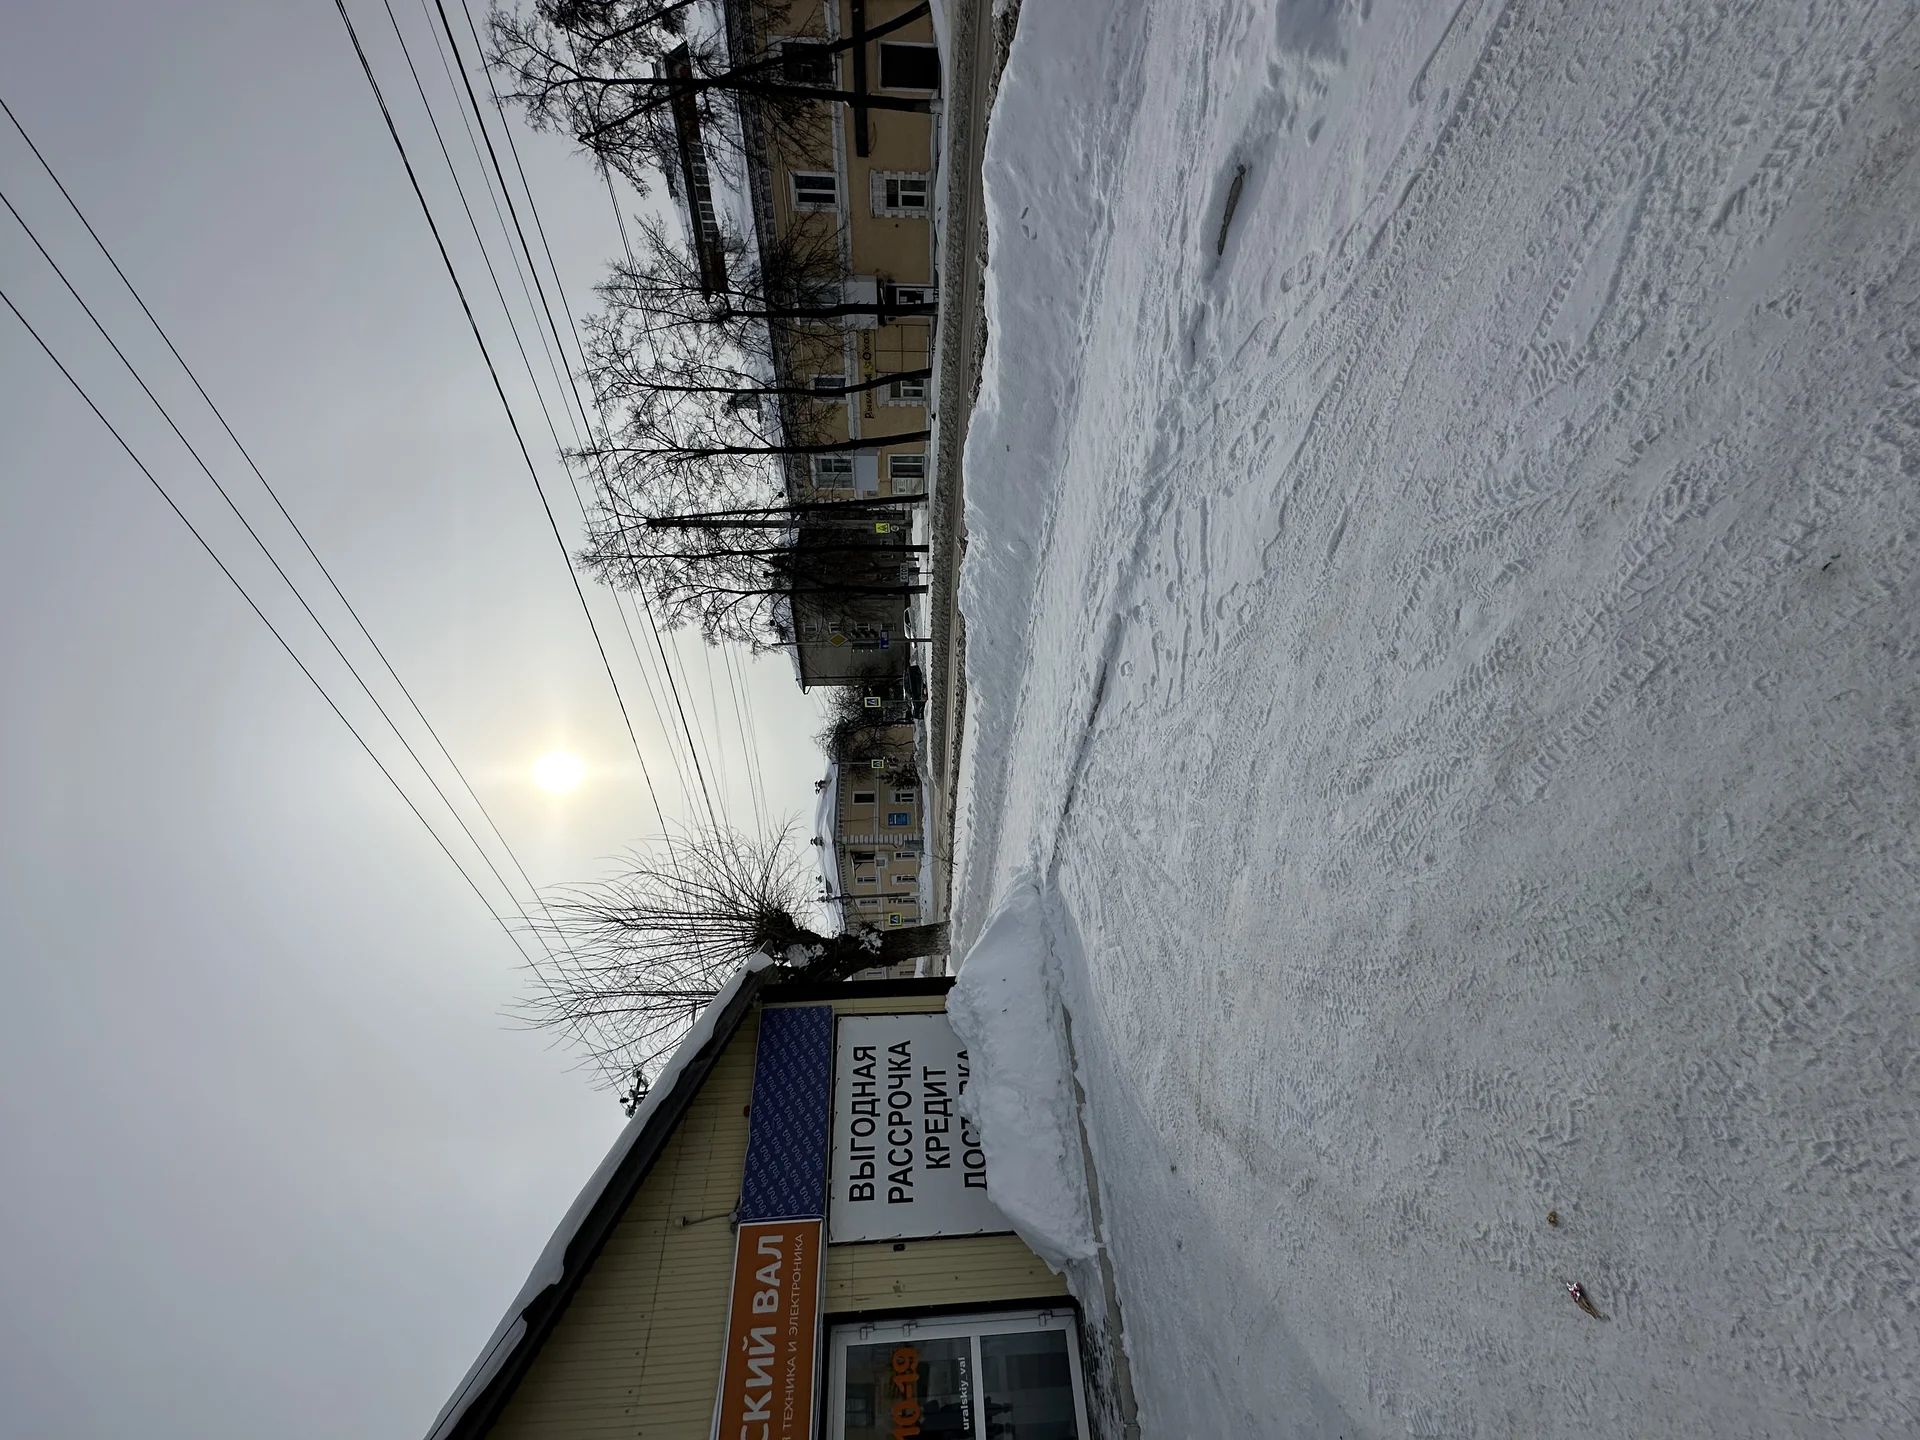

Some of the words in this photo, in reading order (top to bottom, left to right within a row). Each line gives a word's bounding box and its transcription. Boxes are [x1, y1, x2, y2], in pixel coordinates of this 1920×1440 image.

[849, 1045, 880, 1202] ВЫГОДНАЯ
[887, 1040, 914, 1204] РАССРОЧКА
[923, 1066, 953, 1170] КРЕДИТ
[752, 1234, 784, 1314] ВАЛ
[788, 1233, 804, 1336] ЭЛЕКТРОНИКА
[782, 1356, 796, 1430] ТЕХНИКА
[787, 1341, 797, 1352] И
[958, 1356, 970, 1430] uralskiy_val
[892, 1347, 921, 1440] 10-19
